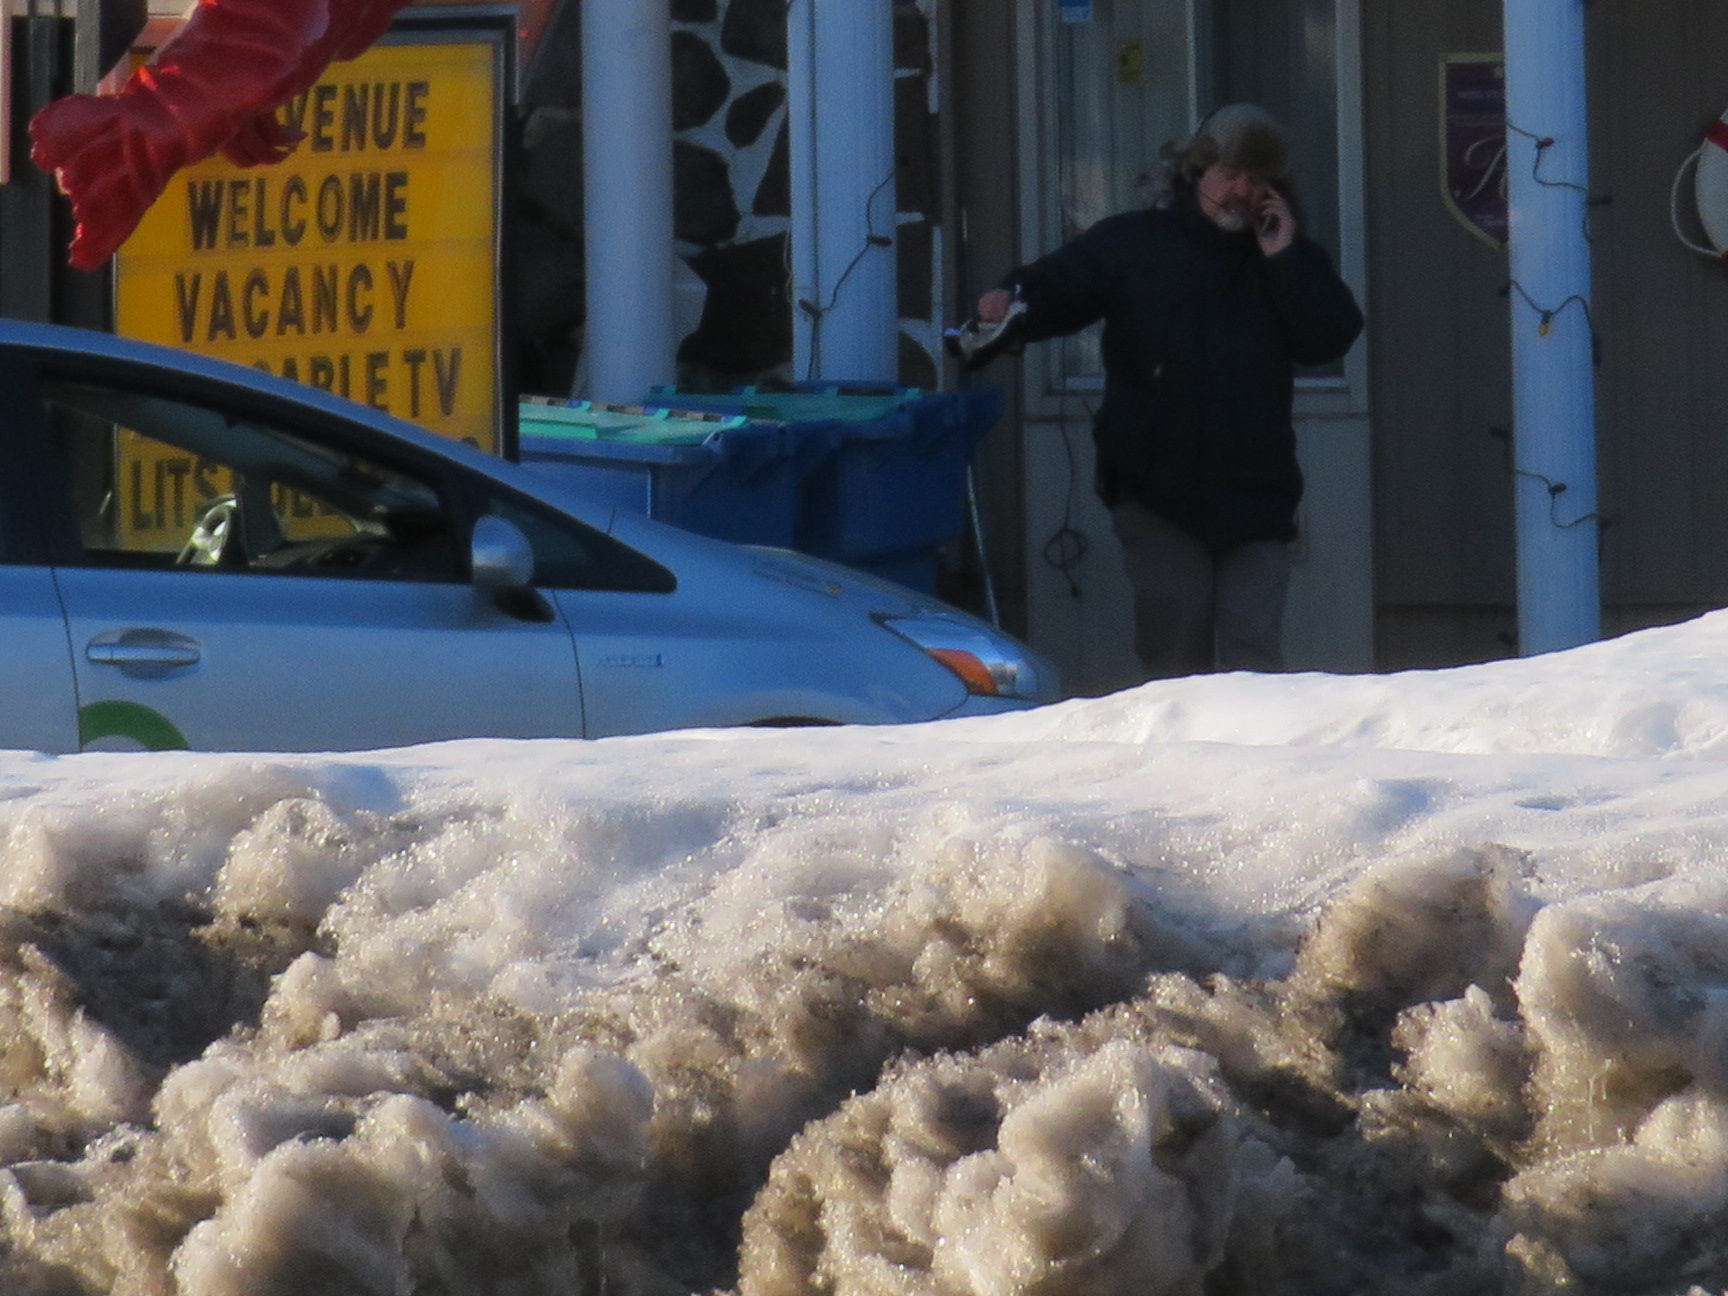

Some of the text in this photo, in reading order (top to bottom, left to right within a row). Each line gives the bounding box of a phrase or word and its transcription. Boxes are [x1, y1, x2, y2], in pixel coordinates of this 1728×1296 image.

[186, 171, 409, 253] WELCOME
[175, 260, 416, 344] VACANCY
[403, 347, 463, 418] TV
